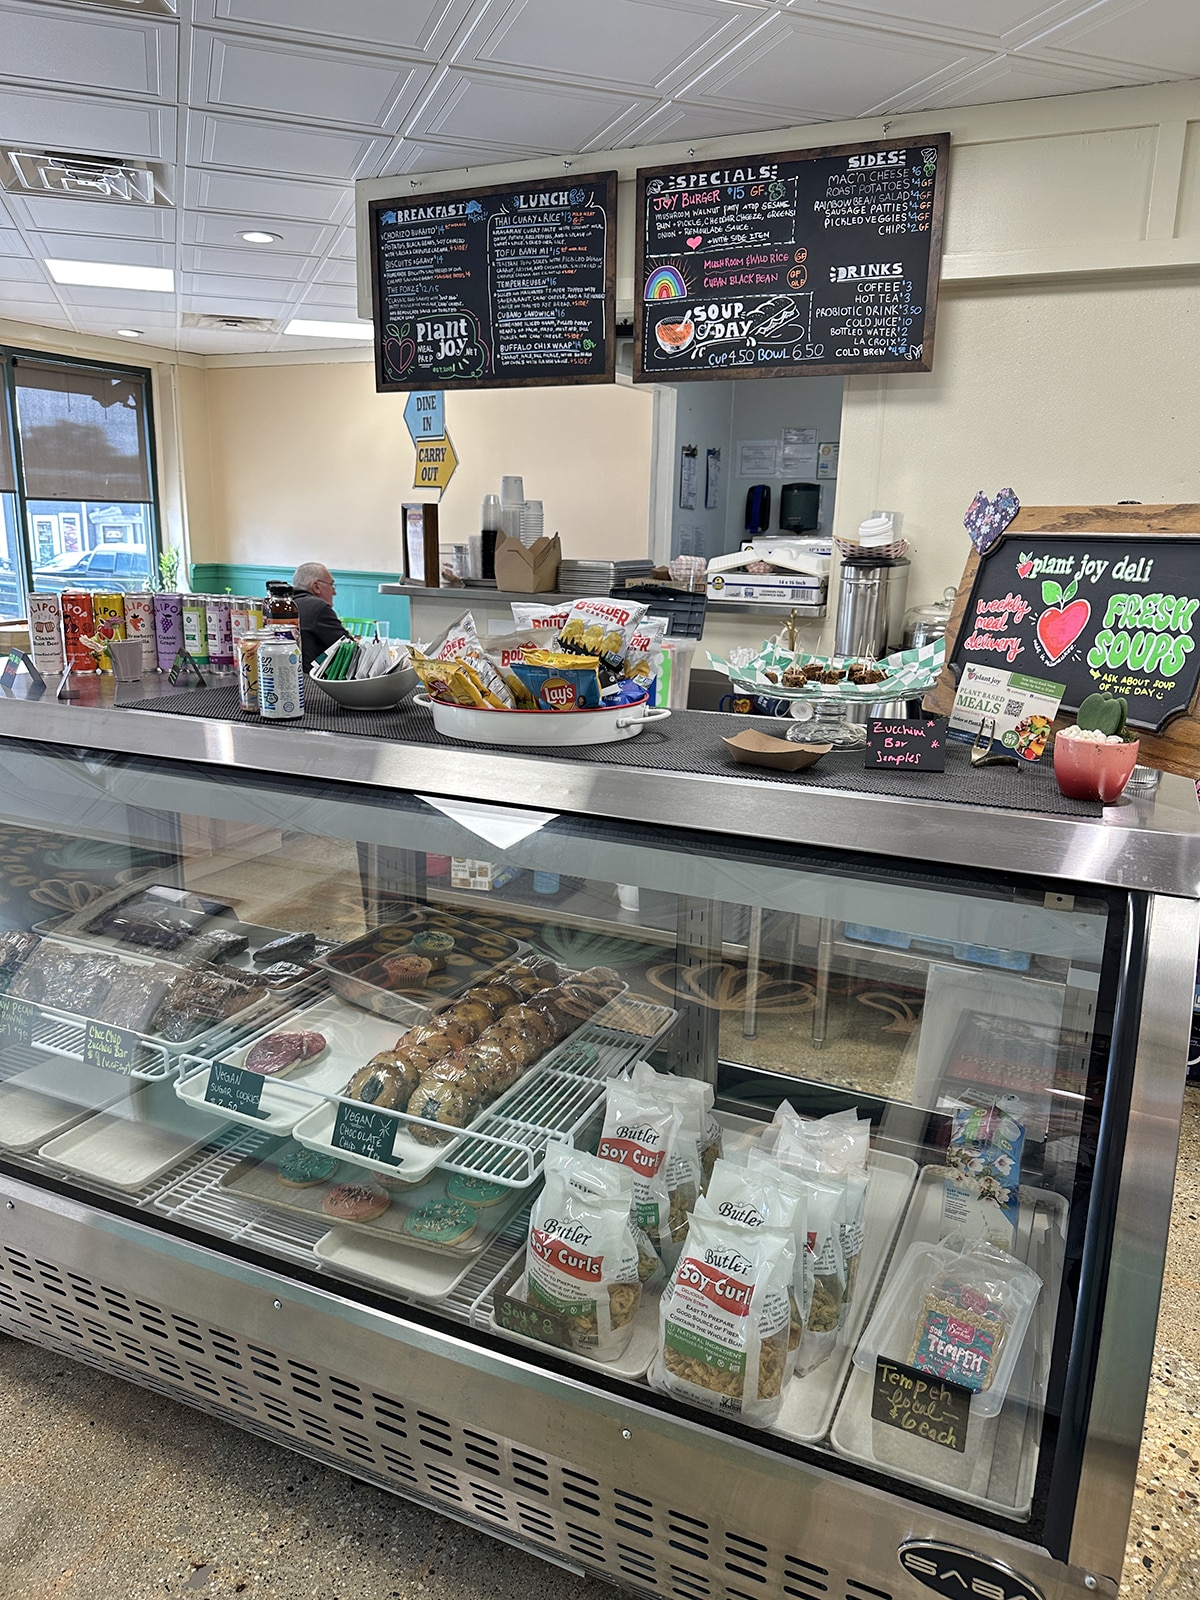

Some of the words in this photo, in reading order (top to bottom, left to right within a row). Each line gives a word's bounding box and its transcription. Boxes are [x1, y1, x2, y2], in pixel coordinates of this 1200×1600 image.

[848, 150, 899, 168] SIDES
[676, 166, 770, 189] SPECIALS
[870, 168, 910, 182] CHEESE
[912, 166, 922, 176] $6
[682, 190, 720, 208] BURGER
[726, 186, 745, 200] $15
[750, 184, 766, 197] GF
[826, 185, 856, 198] ROAST
[858, 179, 911, 194] POTATOES
[912, 178, 920, 188] $4
[921, 178, 933, 187] GF
[520, 192, 569, 208] LUNCH
[814, 198, 852, 212] RAINBOW
[852, 196, 876, 206] BEAN
[878, 191, 910, 202] SALAD
[910, 190, 920, 200] $4
[920, 192, 933, 200] GF
[397, 204, 466, 222] BREAKFAST
[655, 210, 691, 221] MUSHROOM
[692, 206, 720, 217] WALNUT
[825, 206, 866, 218] SAUSAGE
[870, 202, 908, 214] PATTIES
[908, 201, 918, 210] $4
[920, 202, 932, 210] GF
[495, 216, 511, 226] THAI
[512, 215, 537, 224] CURRY
[543, 214, 560, 222] RICE
[656, 222, 671, 230] BUN
[824, 216, 864, 228] PICKLED
[865, 212, 908, 224] VEGGIES
[908, 211, 918, 222] $4
[917, 212, 930, 221] GF
[657, 232, 676, 240] ONION
[878, 222, 907, 236] CHIPS
[906, 222, 918, 232] $2
[918, 222, 930, 232] GF
[495, 248, 516, 258] TOFU
[520, 248, 538, 256] BANH
[704, 258, 744, 270] MUSHROOM
[770, 253, 790, 263] RICE
[385, 258, 412, 270] BISCUITS
[837, 262, 903, 280] DRINKS
[496, 280, 521, 288] TEMPEH
[704, 277, 728, 288] CUBAN
[730, 274, 755, 286] BLACK
[756, 273, 779, 286] BEAN
[857, 282, 900, 292] COFFEE
[902, 280, 913, 292] $3
[854, 294, 876, 303] HOT
[878, 293, 900, 302] TEA
[900, 292, 911, 302] $3
[497, 312, 522, 320] CUBANO
[524, 310, 555, 318] SANDWICH
[694, 302, 744, 322] SOUP
[816, 306, 862, 318] PROBIOTIC
[866, 304, 900, 316] DRINK
[416, 318, 468, 342] Plant
[846, 318, 872, 328] COLD
[873, 317, 898, 328] JUICE
[898, 316, 913, 326] $10
[830, 326, 863, 336] BOTTLED
[866, 327, 898, 337] WATER
[898, 326, 908, 336] $2
[418, 344, 434, 353] MEAL
[436, 338, 468, 360] joy
[500, 344, 532, 352] BUFFALO
[534, 342, 552, 350] CHIX
[854, 337, 866, 346] LA
[868, 337, 897, 346] CROIX
[897, 336, 908, 346] $2
[418, 354, 434, 364] PREP
[708, 353, 728, 366] CUP
[758, 348, 790, 361] BOWL
[836, 348, 860, 357] COLD
[416, 394, 437, 412] DINE
[422, 416, 432, 432] IN
[418, 448, 446, 462] CARRY
[422, 466, 438, 482] OUT
[1031, 555, 1075, 580] plant
[1074, 554, 1110, 584] joy
[1112, 555, 1154, 584] deli
[574, 601, 630, 626] BOULDER
[977, 592, 1032, 624] weekly
[1102, 593, 1200, 633] FRESH
[975, 612, 1009, 632] meal
[964, 632, 1025, 663] delivery
[1087, 628, 1196, 678] SOUPS
[975, 674, 990, 684] plant
[990, 677, 1002, 686] joy
[1102, 673, 1119, 684] ASK
[1121, 675, 1152, 687] ABOUT
[1153, 680, 1176, 691] SOUP
[544, 685, 574, 704] Lay's
[960, 687, 982, 698] PLANT
[982, 692, 1006, 703] BASED
[1099, 682, 1111, 692] OF
[1114, 683, 1132, 694] THE
[1134, 687, 1156, 699] DAY
[956, 694, 1002, 715] MEALS
[872, 722, 925, 737] Zucchini
[884, 739, 909, 748] Bar
[876, 750, 922, 766] Samples
[12, 1002, 34, 1016] PECAN
[106, 1028, 122, 1044] Chip
[114, 1044, 128, 1058] Bar
[210, 1082, 233, 1098] SUGAR
[236, 1090, 260, 1104] COOKIES
[339, 1136, 356, 1151] CHIP
[340, 1122, 382, 1148] CHOCOLATE
[616, 1124, 660, 1145] Butler
[600, 1144, 628, 1164] Soy
[718, 1201, 764, 1228] Butler
[544, 1218, 592, 1246] Butler
[530, 1232, 552, 1260] Soy
[558, 1250, 601, 1274] Curls
[704, 1249, 752, 1276] Butler
[680, 1264, 710, 1293] Soy
[676, 1308, 692, 1319] GOOD
[692, 1314, 713, 1328] SOURCE
[714, 1324, 723, 1332] OF
[722, 1328, 740, 1338] FIBER
[686, 1304, 700, 1314] EASY
[700, 1310, 708, 1318] TO
[708, 1313, 735, 1329] PREPARE
[670, 1312, 696, 1328] CONTAINS
[696, 1325, 706, 1334] THE
[707, 1329, 728, 1342] WHOLE
[676, 1327, 704, 1345] NATURAL
[704, 1341, 742, 1360] INGREDIENT
[928, 1334, 984, 1372] TEMPEH
[878, 1363, 952, 1405] Tempeh
[888, 1404, 916, 1430] $6
[918, 1420, 958, 1448] each
[904, 1552, 1027, 1600] SAB
